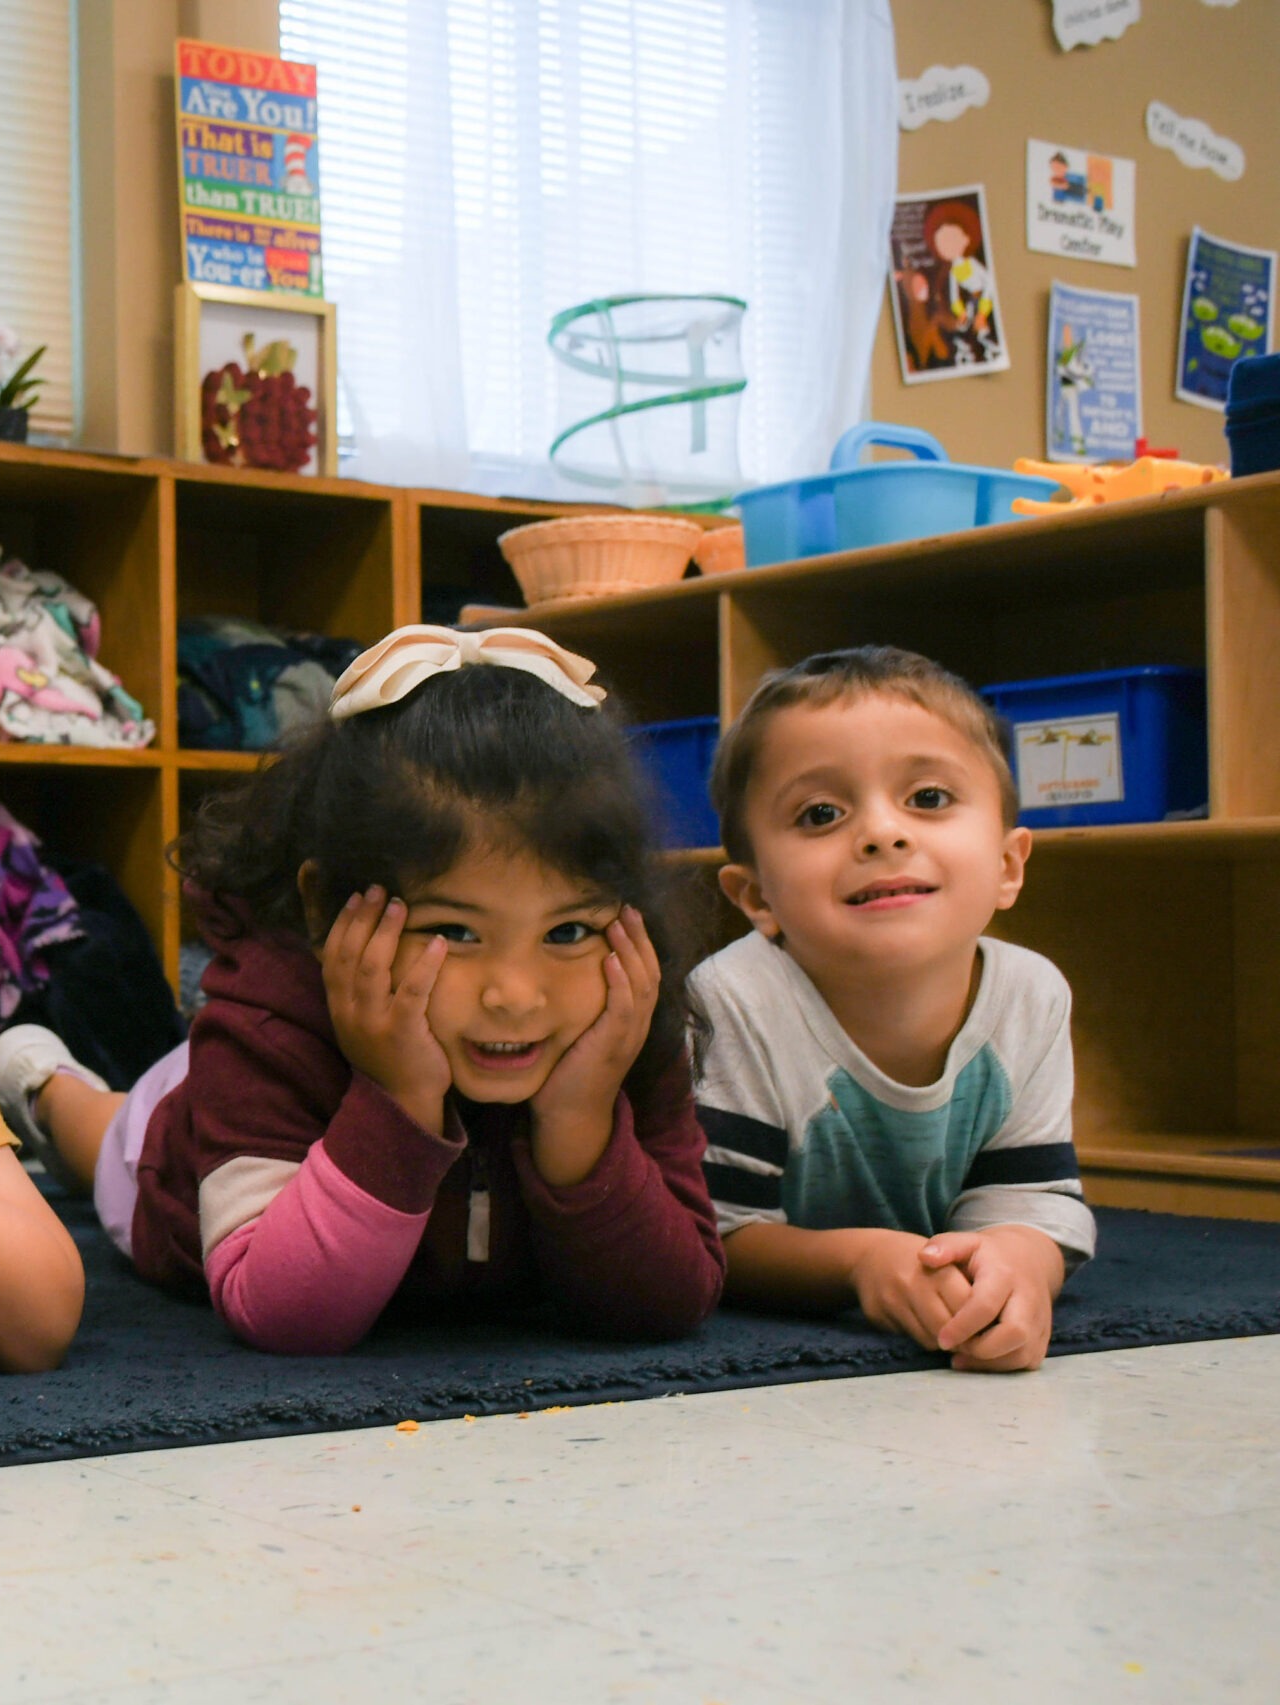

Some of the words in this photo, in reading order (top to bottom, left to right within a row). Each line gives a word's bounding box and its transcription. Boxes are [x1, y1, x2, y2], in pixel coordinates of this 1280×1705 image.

[183, 47, 312, 93] TODAY
[185, 86, 239, 120] Are
[238, 87, 317, 132] You!
[183, 121, 246, 156] That
[249, 133, 273, 160] is
[186, 151, 274, 187] TRUER
[185, 181, 239, 211] than
[240, 189, 320, 224] TRUE!
[1038, 202, 1095, 231] Dramatic
[1099, 215, 1124, 240] Play
[186, 217, 234, 241] There
[234, 225, 251, 244] is
[1061, 234, 1102, 255] Center
